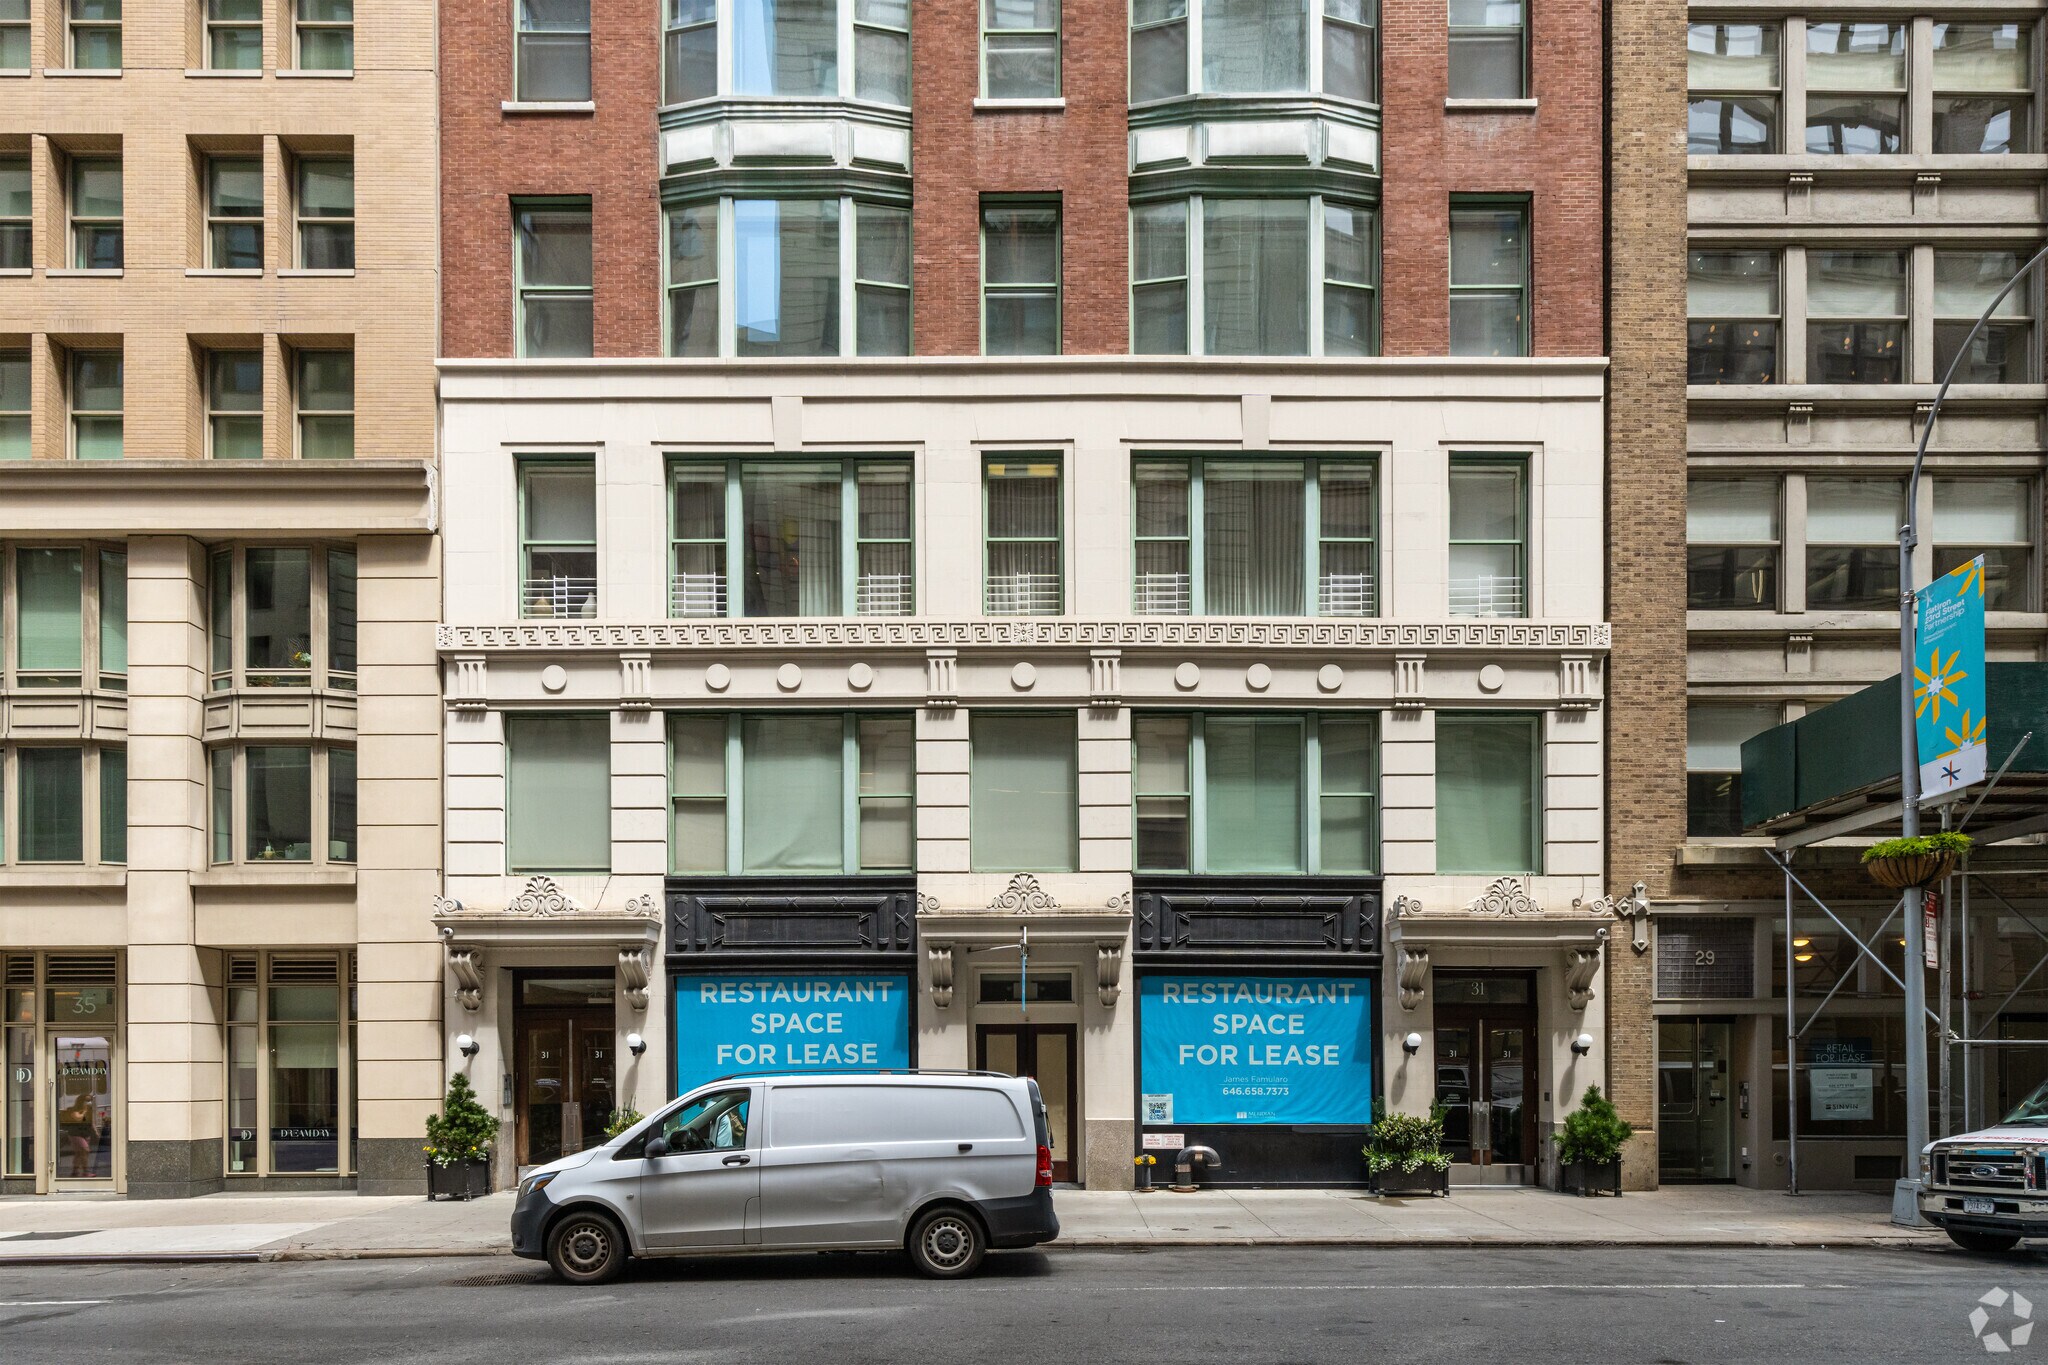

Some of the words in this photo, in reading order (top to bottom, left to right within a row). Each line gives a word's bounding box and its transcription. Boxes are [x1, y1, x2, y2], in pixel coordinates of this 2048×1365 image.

[1925, 599, 1951, 617] Flatiron
[1925, 610, 1940, 624] 23rd
[1942, 599, 1965, 616] Street
[1924, 608, 1965, 632] Partnership
[1695, 950, 1715, 966] 29
[700, 981, 894, 1003] RESTAURANT
[1162, 982, 1356, 1004] RESTAURANT
[1471, 981, 1484, 996] 31
[72, 996, 96, 1014] 35
[750, 1012, 843, 1034] SPACE
[1212, 1013, 1305, 1035] SPACE
[541, 1051, 550, 1059] 31
[594, 1050, 603, 1059] 31
[716, 1044, 776, 1065] FOR
[787, 1043, 878, 1064] LEASE
[1179, 1044, 1239, 1066] FOR
[1248, 1044, 1340, 1066] LEASE
[1449, 1050, 1457, 1058] 31
[1503, 1050, 1511, 1058] 31
[1826, 1043, 1854, 1053] RETAIL
[1815, 1053, 1835, 1063] FOR
[1836, 1053, 1866, 1063] LEASE
[1224, 1075, 1249, 1083] James
[1251, 1075, 1289, 1083] Famularo
[1222, 1087, 1289, 1096] 646.658.7373
[280, 1129, 330, 1138] DREAMDRY
